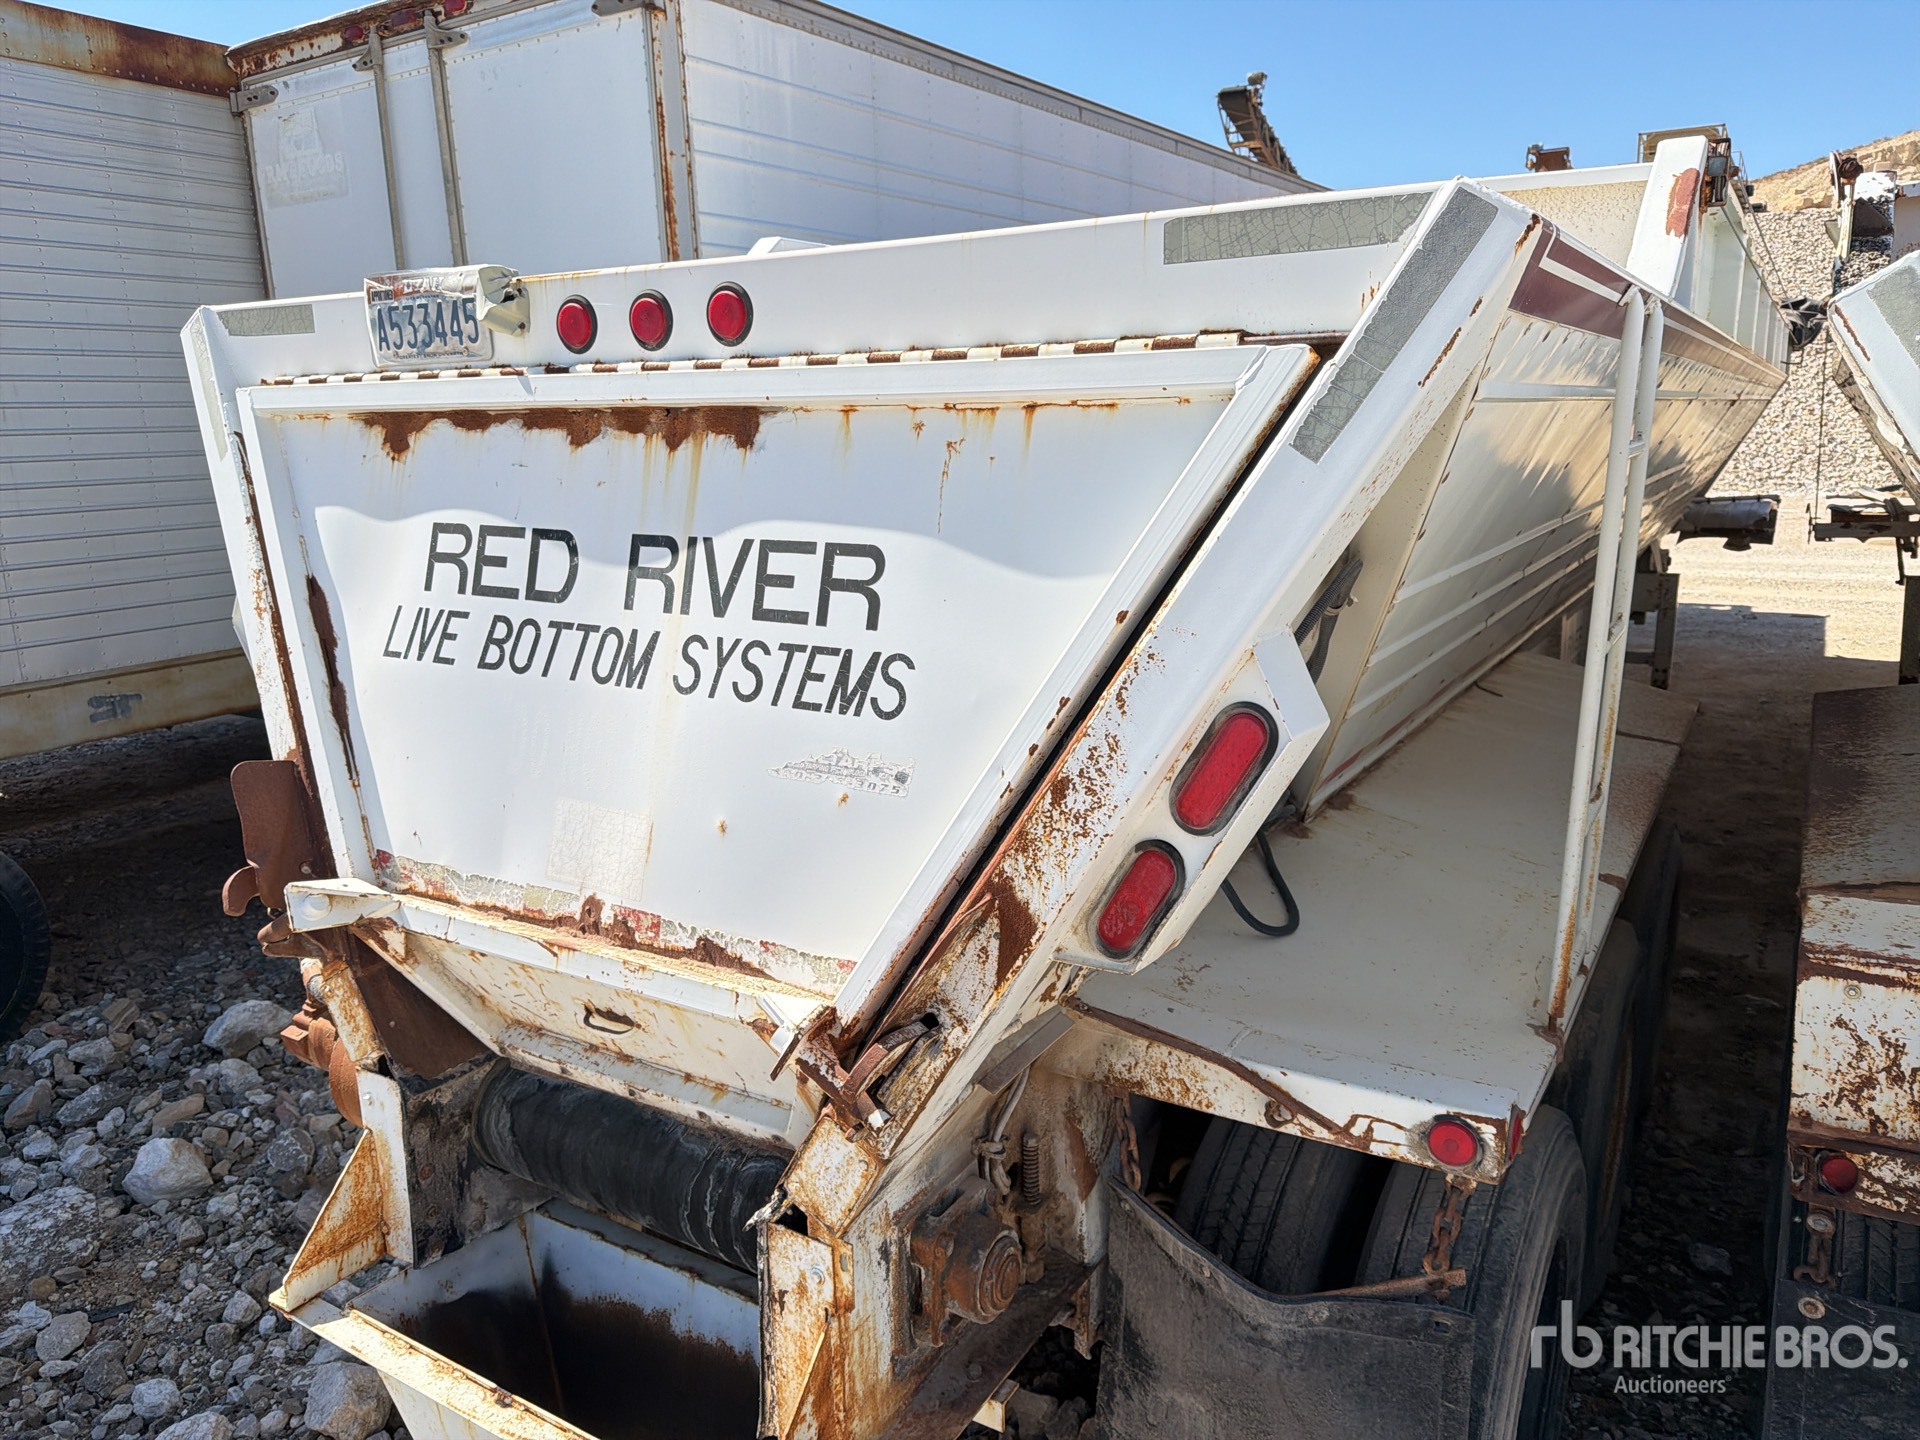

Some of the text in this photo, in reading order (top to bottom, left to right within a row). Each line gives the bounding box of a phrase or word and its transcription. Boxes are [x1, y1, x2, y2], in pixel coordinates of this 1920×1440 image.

[377, 298, 479, 351] A533445
[425, 523, 885, 630] RED RIVER
[383, 606, 915, 720] LIVE BOTTOM SYSTEMS
